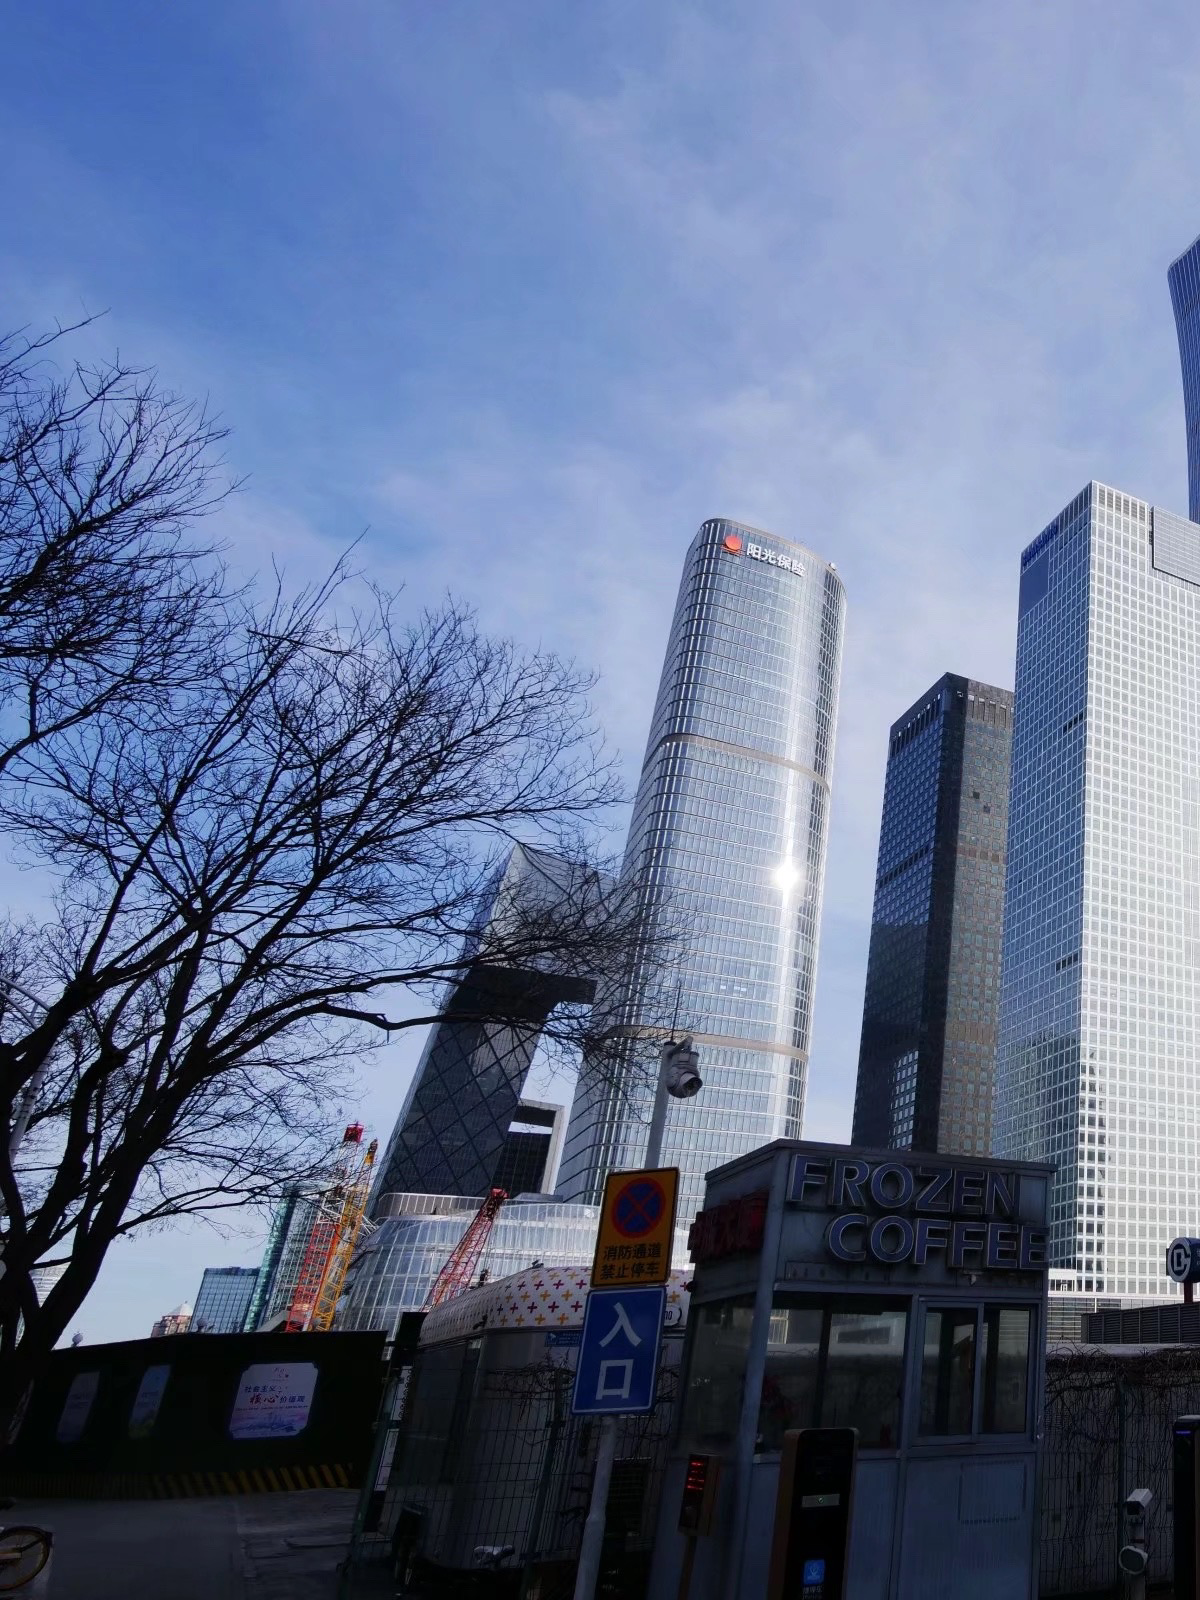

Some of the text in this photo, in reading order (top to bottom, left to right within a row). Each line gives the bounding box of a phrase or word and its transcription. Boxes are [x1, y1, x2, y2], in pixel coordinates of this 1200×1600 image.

[747, 542, 806, 577] 阳光保险
[789, 1154, 1017, 1216] FROZEN
[603, 1242, 662, 1261] 消防通道
[828, 1213, 1050, 1270] COFFEE
[600, 1262, 660, 1280] 禁止停车
[595, 1301, 643, 1401] 入口
[244, 1385, 276, 1393] 社会主义
